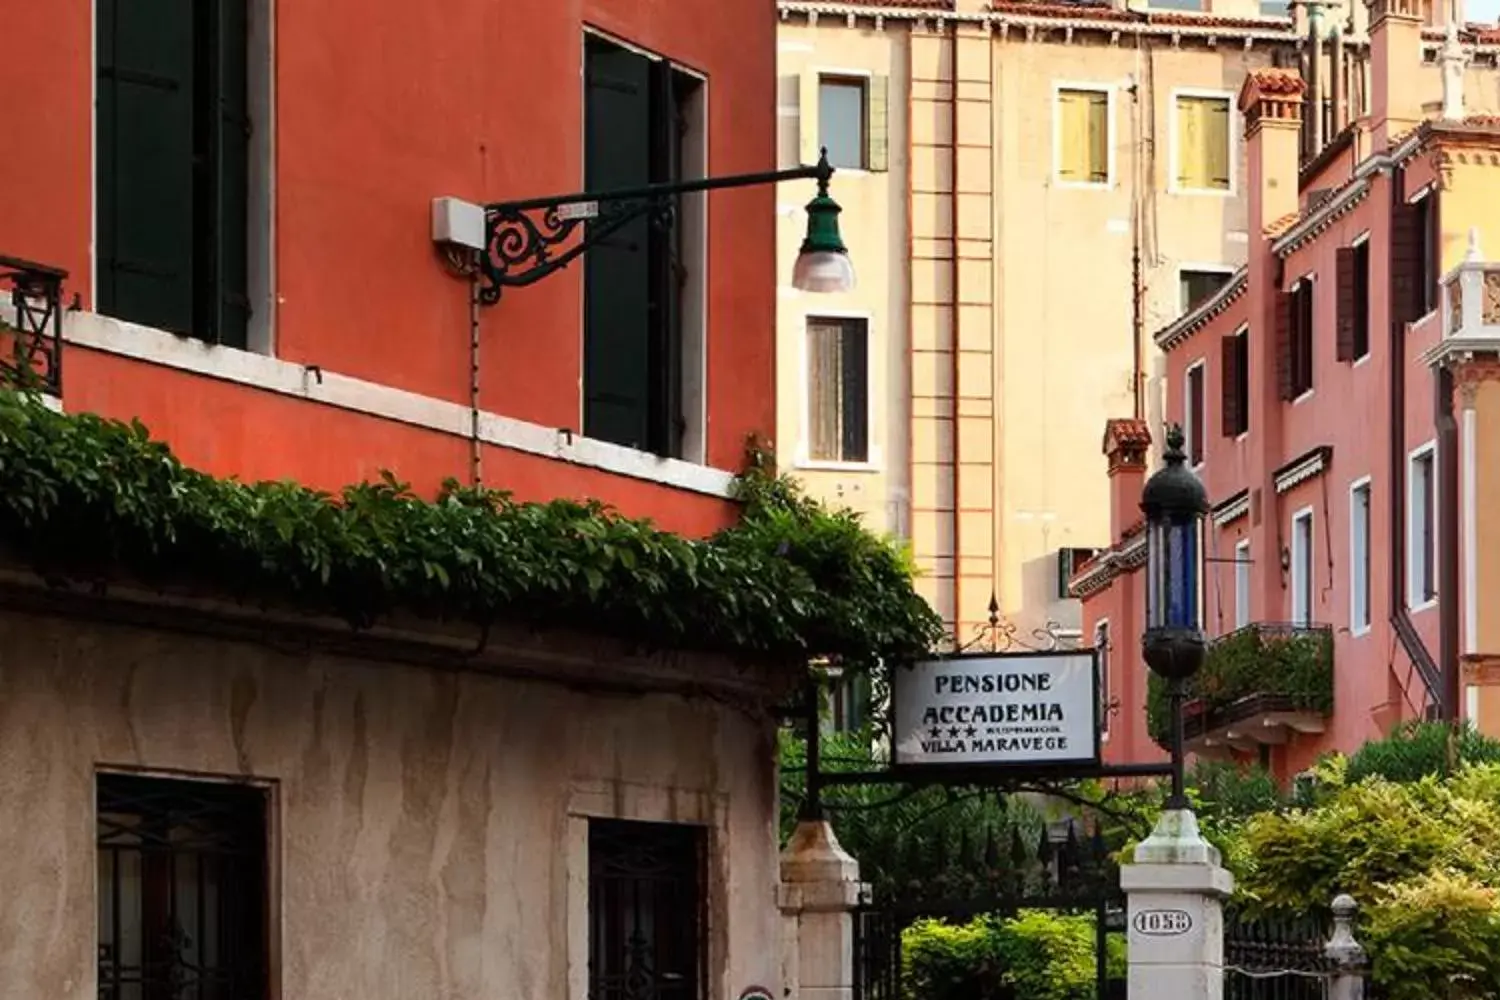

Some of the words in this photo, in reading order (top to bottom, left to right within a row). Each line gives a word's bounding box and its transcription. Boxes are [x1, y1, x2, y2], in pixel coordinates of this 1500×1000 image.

[935, 673, 1051, 694] PENSIONE
[923, 704, 1064, 724] ACCADEMIA
[921, 740, 967, 753] VILLA
[971, 737, 1068, 752] MARAVEGE
[1138, 913, 1187, 930] 1058
